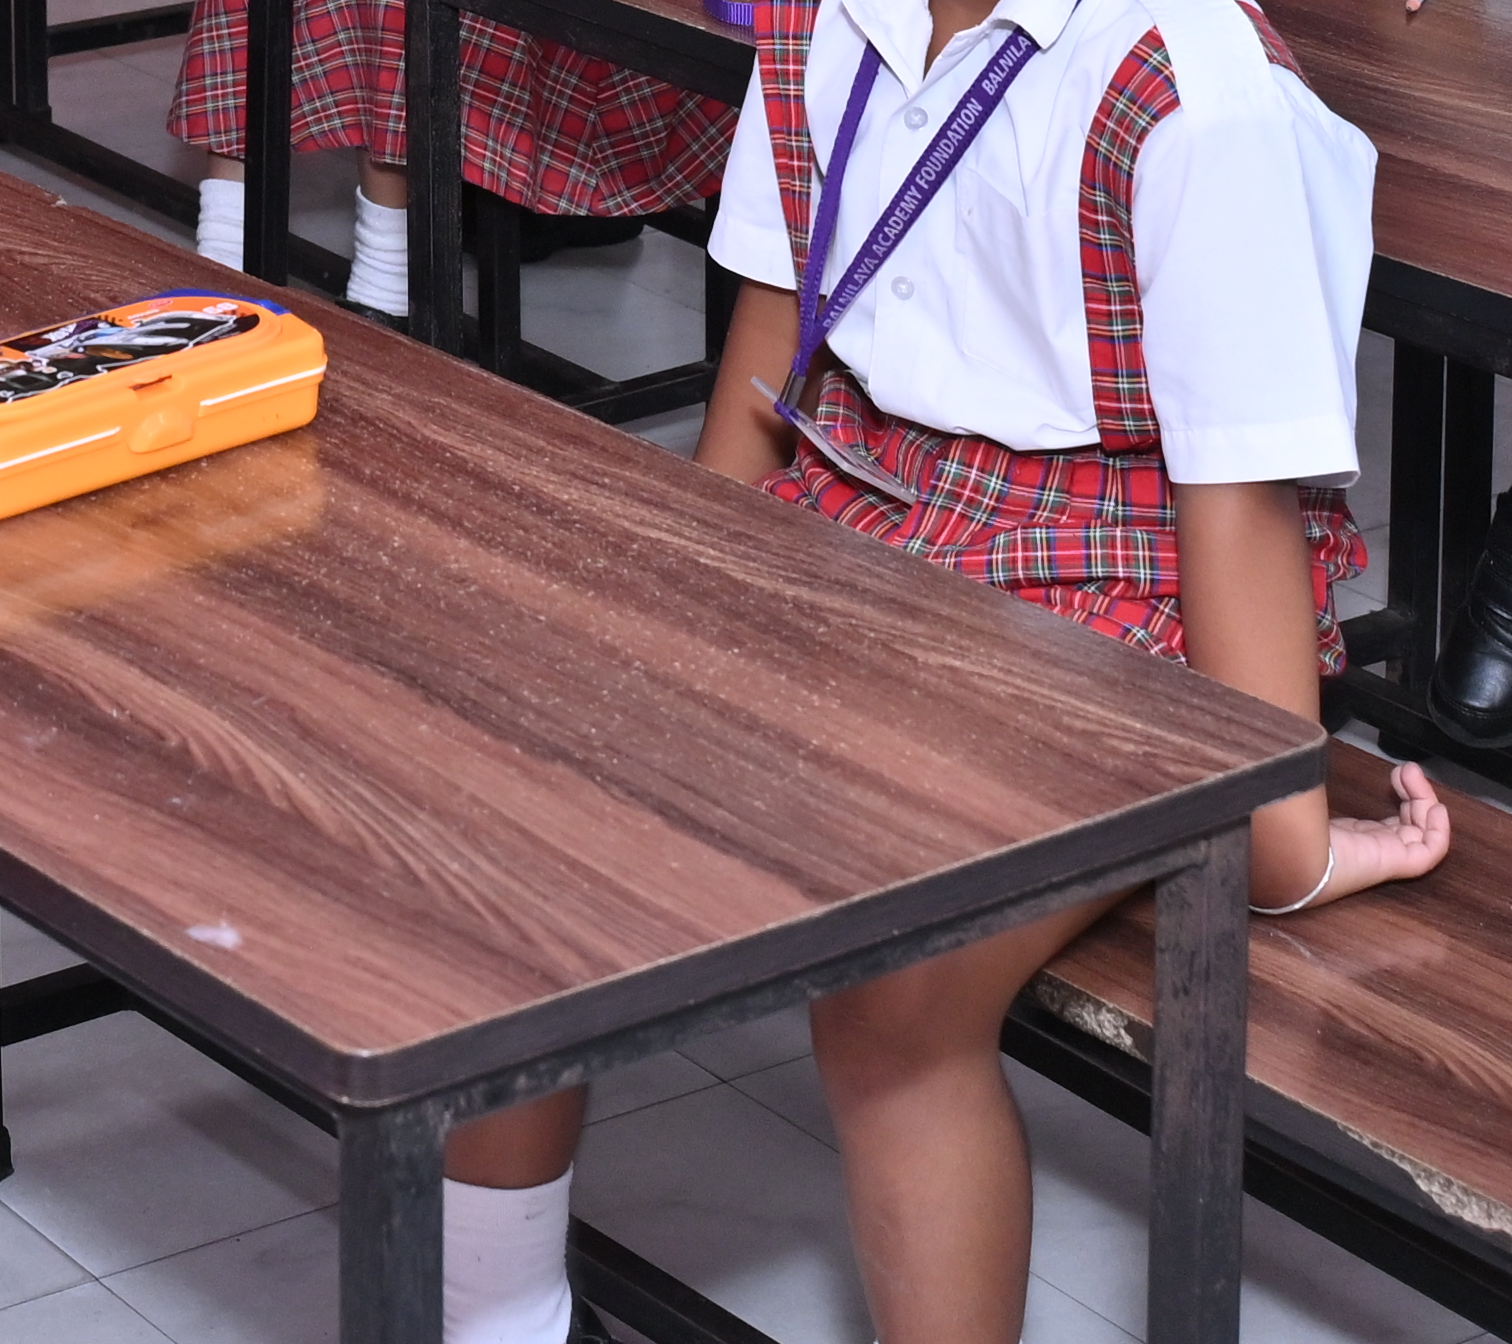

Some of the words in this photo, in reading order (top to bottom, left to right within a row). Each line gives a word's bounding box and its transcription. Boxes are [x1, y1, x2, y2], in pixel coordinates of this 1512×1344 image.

[822, 257, 879, 329] BALNILAYA
[872, 185, 924, 259] ACADEMY
[914, 97, 984, 190] FOUNDATION
[981, 33, 1033, 96] BALNILA
